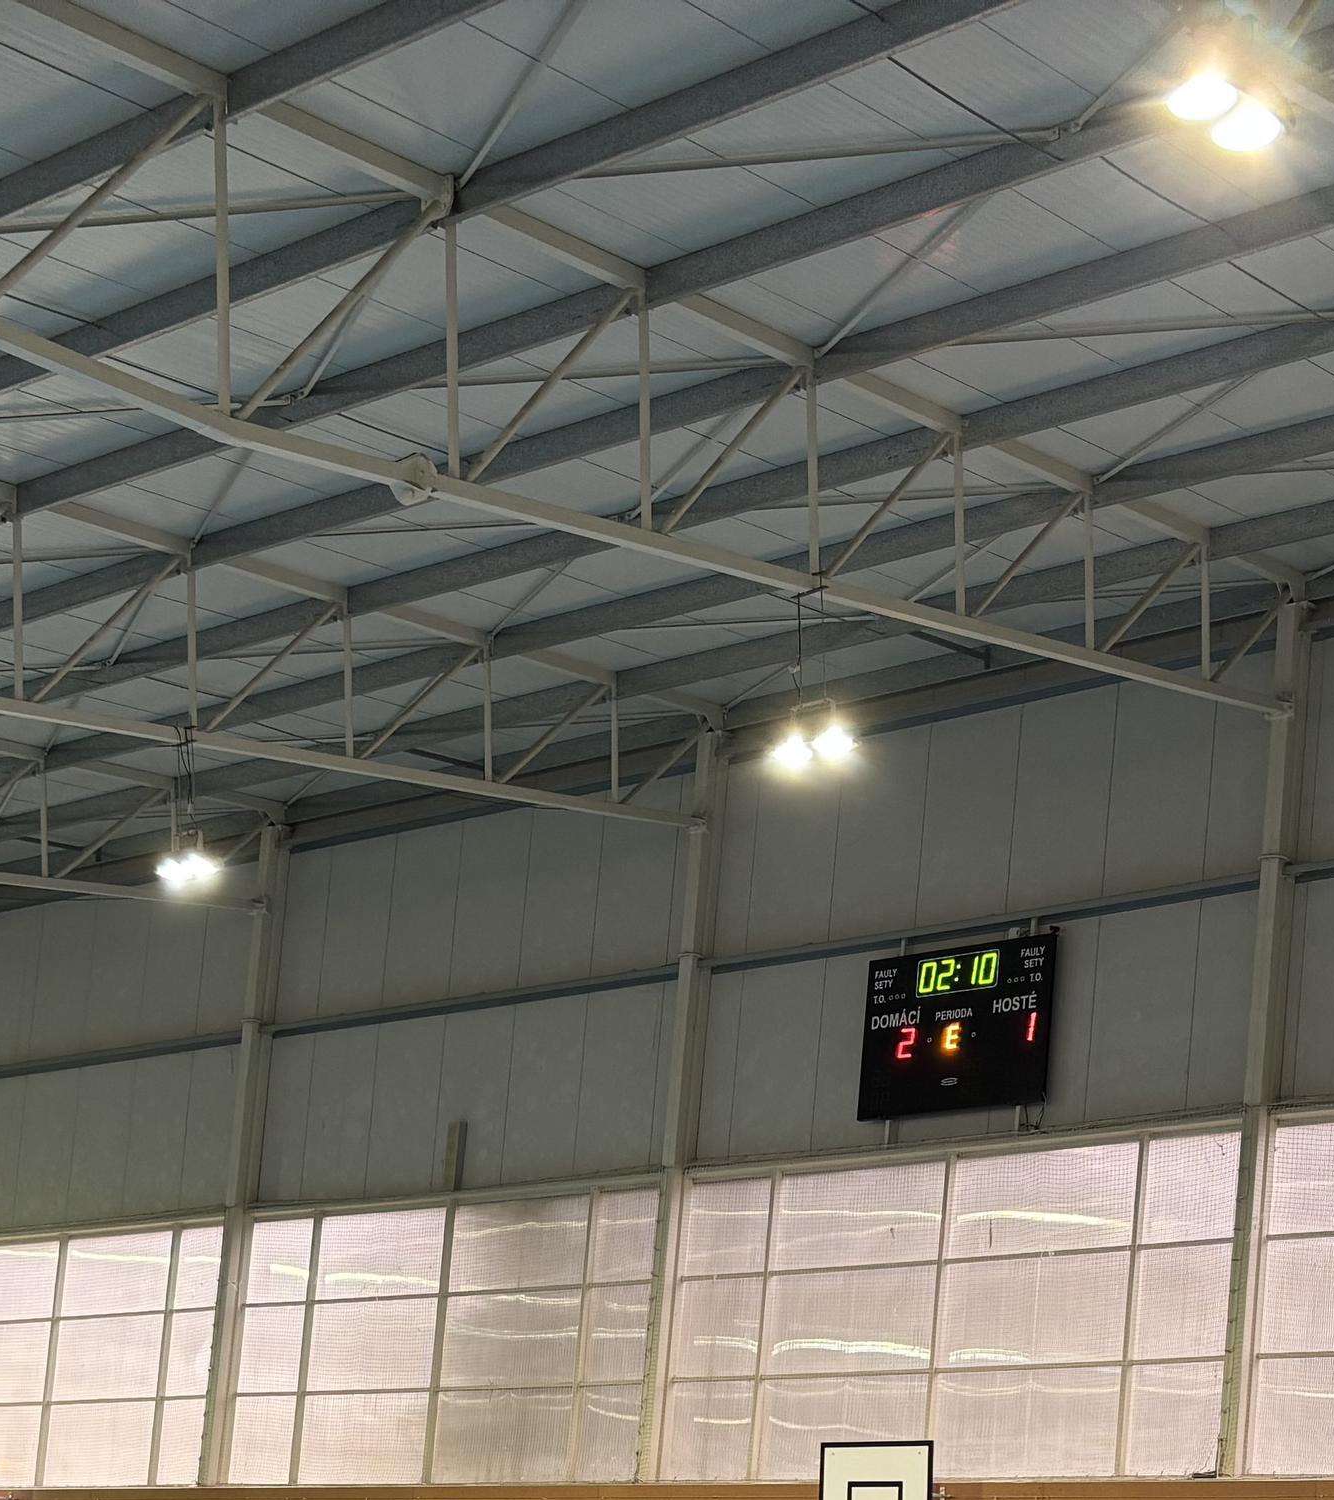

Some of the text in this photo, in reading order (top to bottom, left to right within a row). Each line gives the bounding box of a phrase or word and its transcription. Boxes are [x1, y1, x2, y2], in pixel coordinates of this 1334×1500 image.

[1020, 946, 1045, 958] FAULY
[1024, 957, 1045, 968] SETY
[875, 968, 898, 979] FAULY
[919, 953, 998, 993] 02:10
[874, 979, 893, 990] SETY
[993, 991, 1037, 1013] HOSTÉ
[871, 1006, 921, 1030] DOMÁCÍ
[935, 1007, 973, 1021] PERIODA
[896, 1028, 916, 1059] 2
[1026, 1012, 1037, 1041] 1
